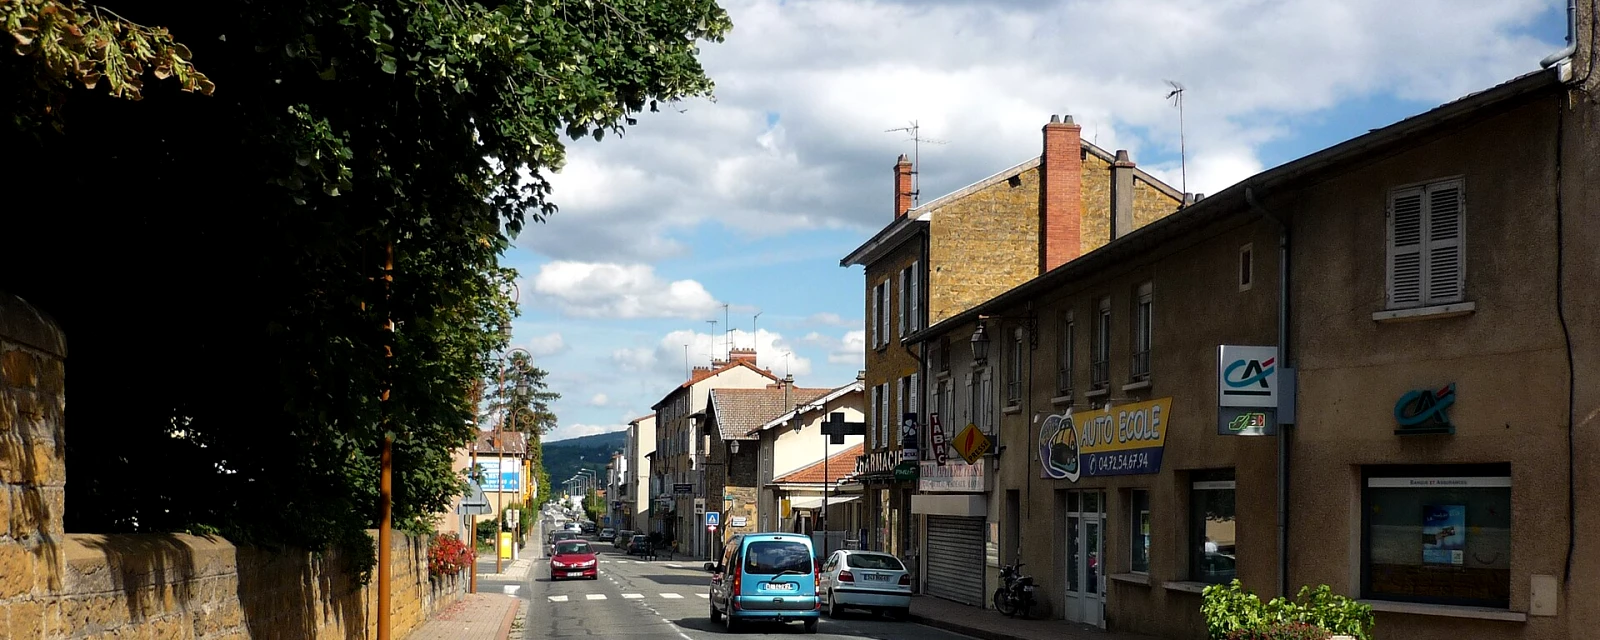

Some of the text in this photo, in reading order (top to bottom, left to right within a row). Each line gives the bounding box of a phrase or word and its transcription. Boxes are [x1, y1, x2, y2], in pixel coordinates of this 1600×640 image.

[932, 414, 945, 464] TABAC
[1081, 414, 1115, 447] AUTO
[1118, 405, 1161, 443] ECOLE
[854, 449, 904, 475] PHARMACIE
[968, 440, 989, 462] PRESSE
[1098, 452, 1149, 472] 04.72.54.67.94
